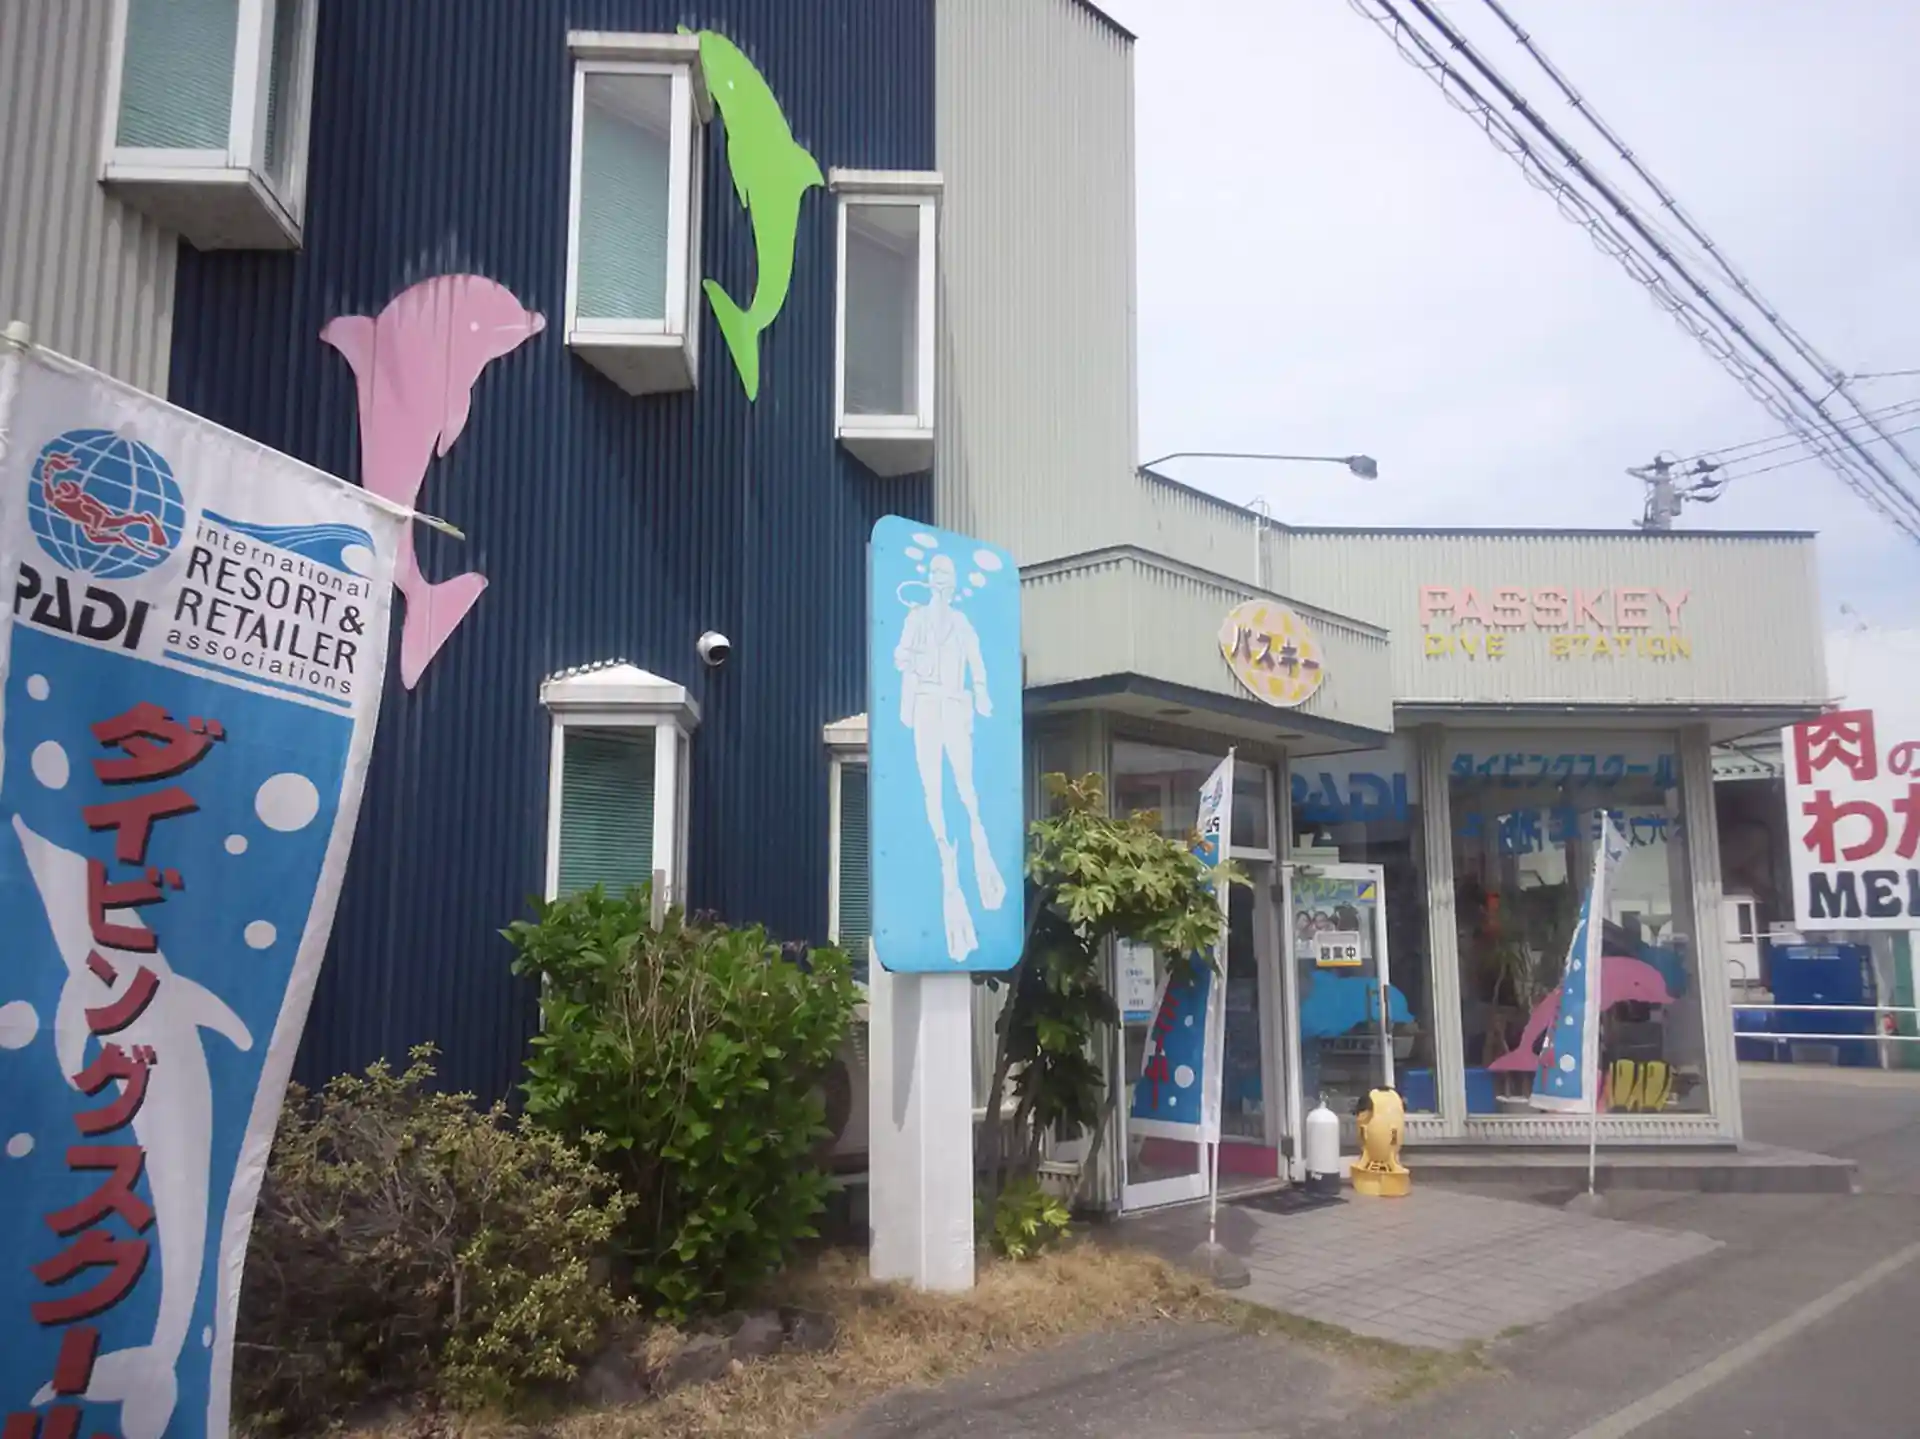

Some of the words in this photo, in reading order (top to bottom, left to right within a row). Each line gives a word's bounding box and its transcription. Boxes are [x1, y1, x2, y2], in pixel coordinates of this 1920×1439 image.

[186, 545, 337, 627] RESORT
[338, 604, 365, 637] &
[197, 525, 371, 600] international
[13, 561, 149, 650] PADI
[174, 585, 359, 675] RETAILER
[1419, 584, 1692, 633] PASSKEY
[166, 626, 353, 696] associations
[1424, 632, 1507, 661] DIVE
[1549, 632, 1694, 662] STATION
[1291, 773, 1409, 823] PADI
